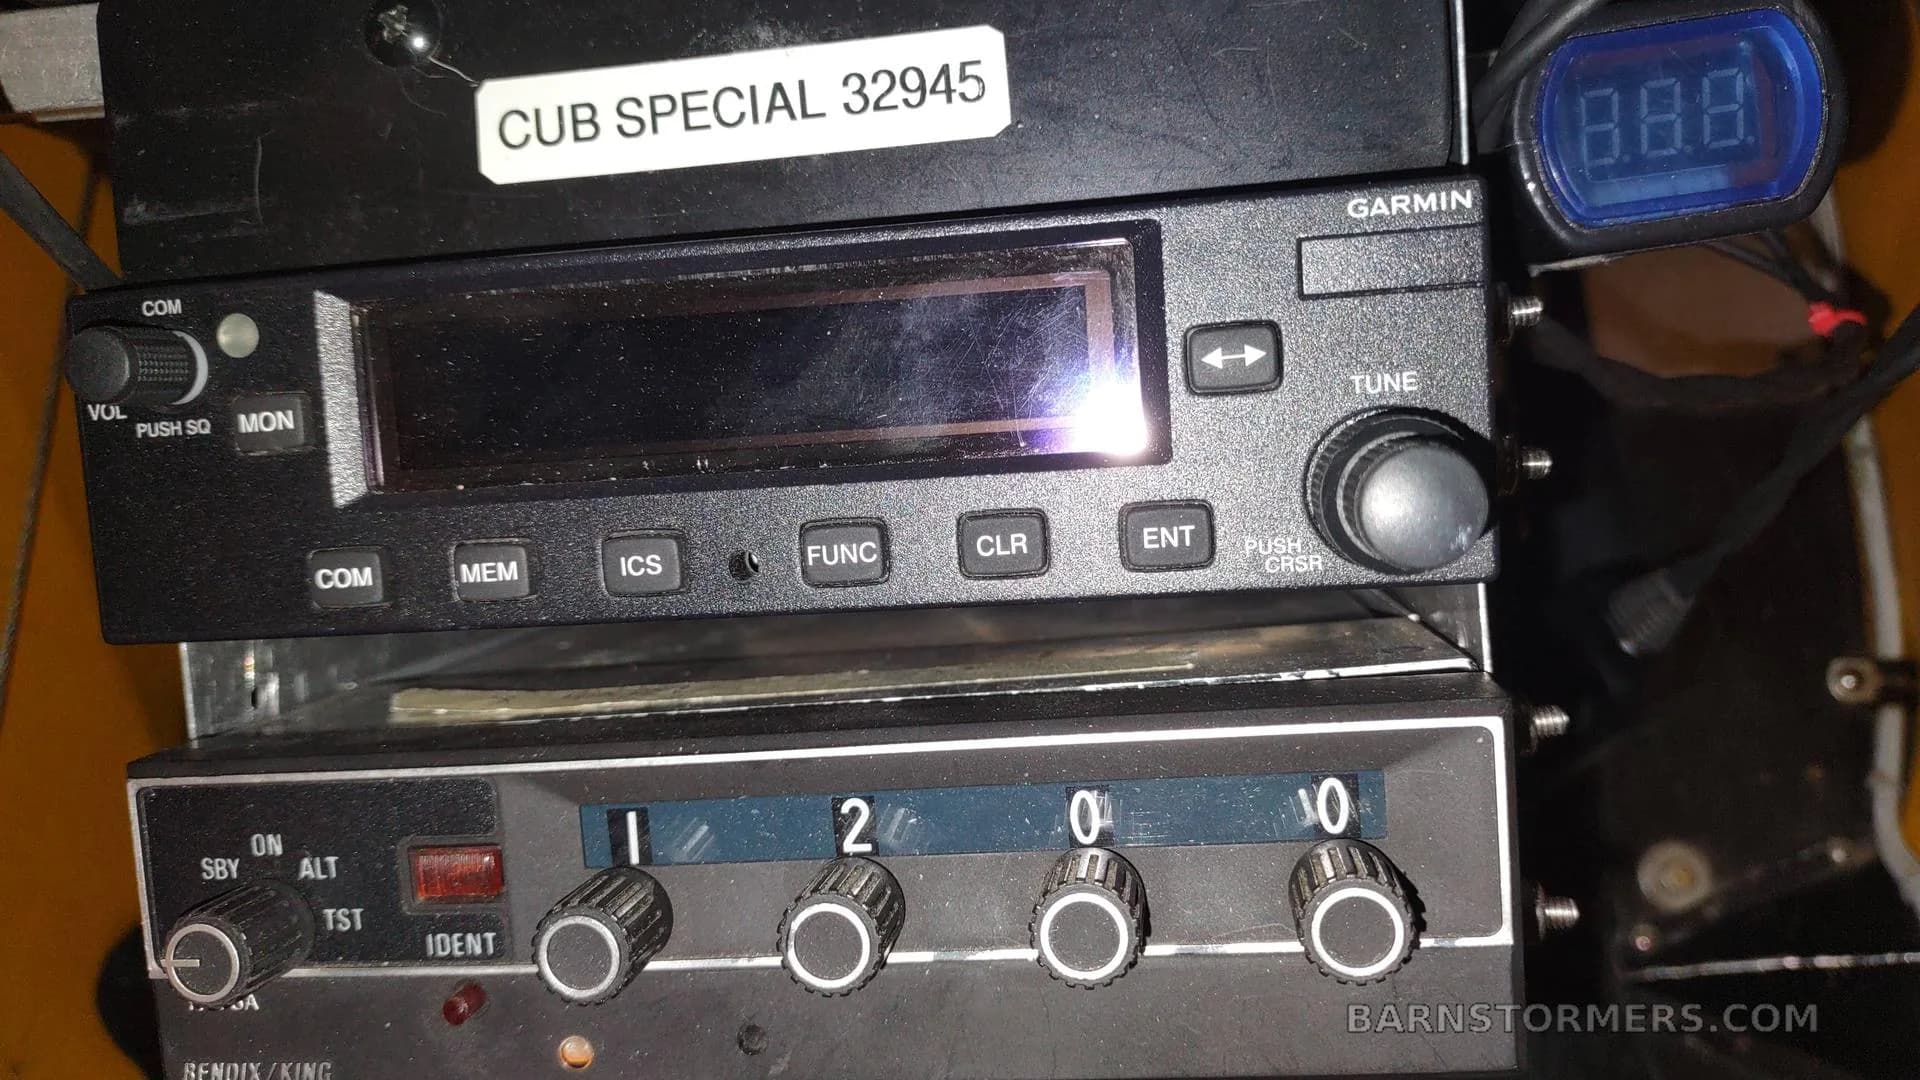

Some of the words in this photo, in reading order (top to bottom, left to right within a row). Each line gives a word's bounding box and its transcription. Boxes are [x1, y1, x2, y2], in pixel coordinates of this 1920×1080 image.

[499, 102, 600, 151] CUB
[615, 79, 827, 140] SPECIAL
[841, 59, 987, 116] 32945
[1347, 190, 1473, 219] GARMIN
[142, 299, 182, 317] COM
[1350, 371, 1418, 395] TUNE
[87, 403, 128, 422] VOL
[237, 409, 295, 434] MON
[136, 421, 182, 438] PUSH
[185, 419, 211, 436] SQ
[976, 533, 1028, 557] CLR
[1142, 525, 1196, 550] ENT
[1245, 538, 1302, 556] PUSH
[620, 554, 663, 578] ICS
[806, 542, 878, 567] FUNC
[1265, 555, 1324, 574] CRSR
[314, 566, 373, 590] COM
[459, 561, 519, 584] MEM
[625, 810, 640, 866] 1
[840, 798, 874, 855] 2
[1316, 777, 1351, 836] 0
[250, 833, 283, 857] ON
[201, 857, 241, 880] SBY
[299, 856, 340, 880] ALT
[323, 908, 364, 931] TST
[425, 931, 497, 957] IDENT
